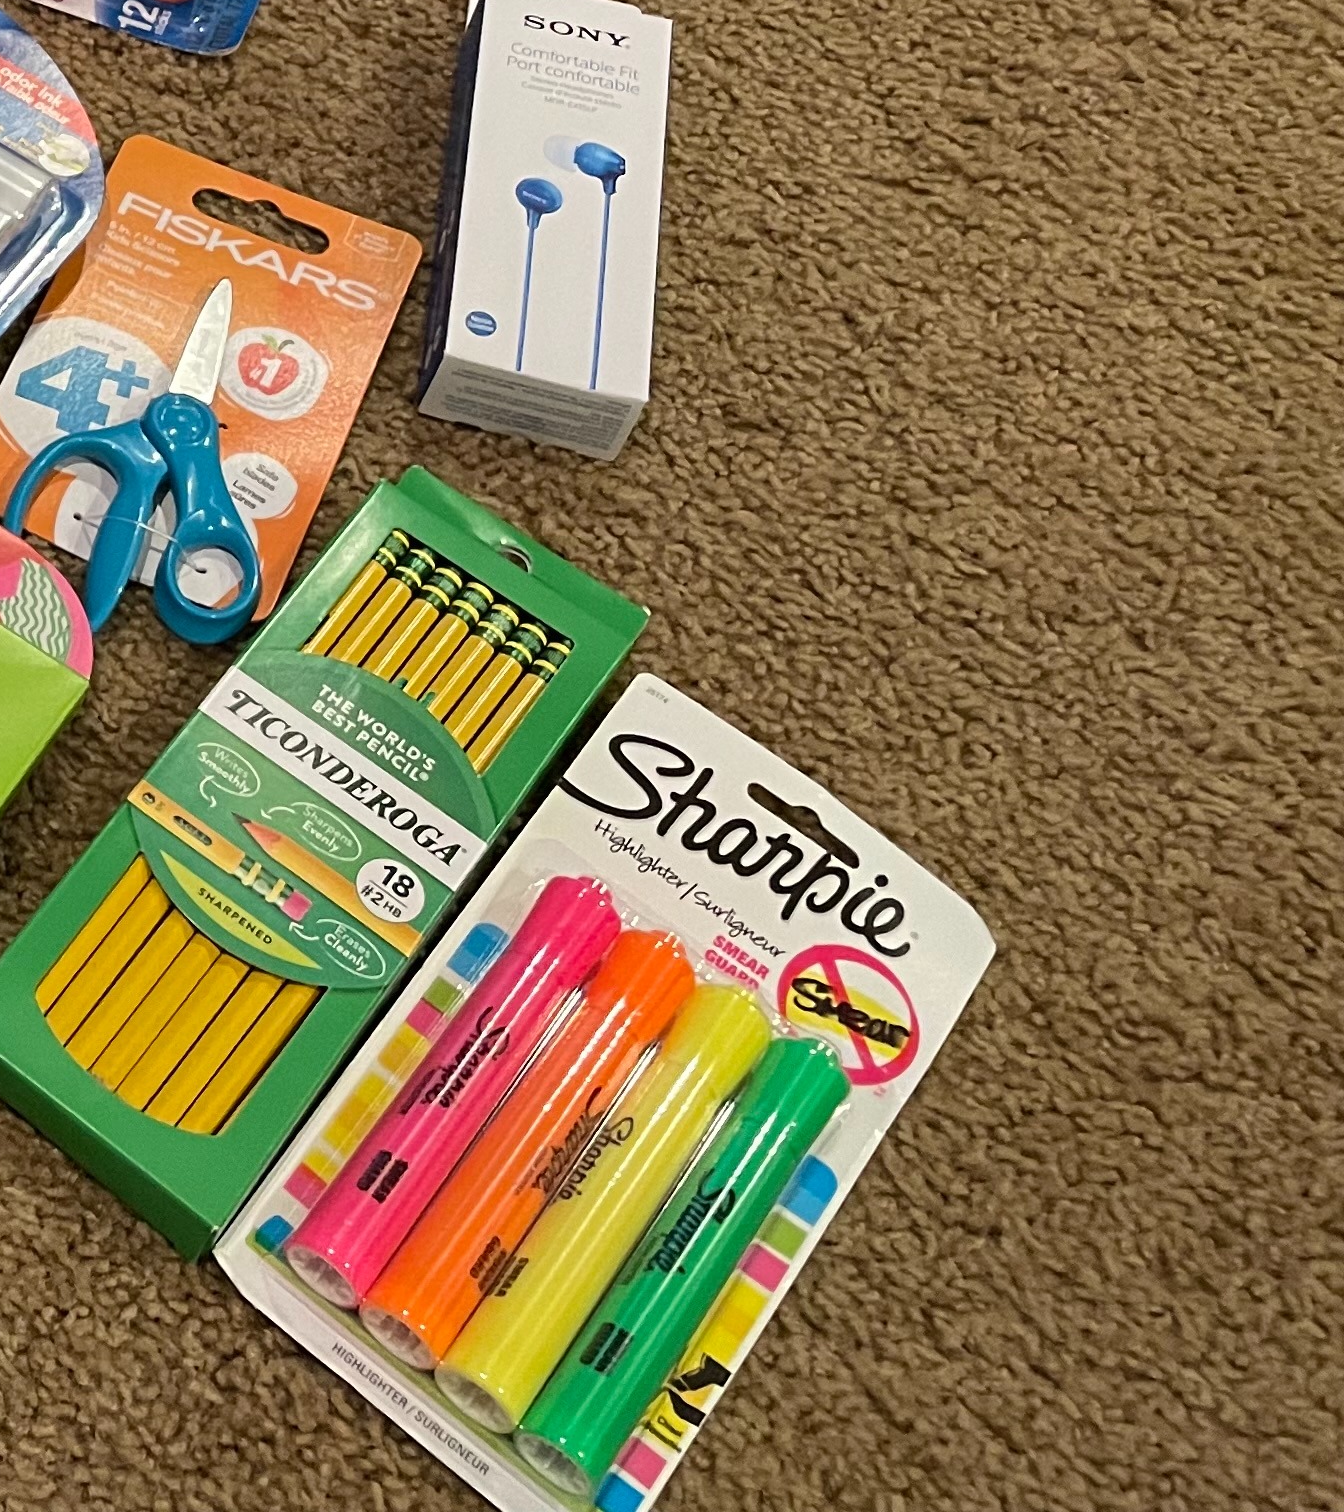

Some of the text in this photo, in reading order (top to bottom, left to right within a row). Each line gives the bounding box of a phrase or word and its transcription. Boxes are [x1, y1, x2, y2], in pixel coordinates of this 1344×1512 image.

[117, 0, 159, 32] 12
[524, 14, 630, 48] SONY
[0, 68, 38, 91] odor
[506, 55, 640, 97] Port confortable
[511, 42, 640, 81] Comfortable Fit
[117, 191, 376, 311] FISKARS
[311, 700, 357, 735] BEST
[318, 685, 437, 773] THE WORLD'S
[198, 751, 251, 795] Smoothly
[214, 746, 250, 780] Writes
[224, 688, 462, 868] TICONDEROGA
[301, 804, 354, 849] Sharpens
[302, 819, 340, 854] Evenly
[559, 733, 912, 958] Sharpie
[381, 863, 417, 899] 18
[593, 818, 688, 890] Highlighter
[694, 890, 788, 959] Surligneur
[196, 887, 274, 946] SHARPENED
[323, 932, 371, 972] Cleanly
[334, 924, 372, 960] Erases
[712, 934, 771, 980] SMEAR
[791, 977, 911, 1049] Smear
[332, 1342, 409, 1409] HIGHLIGHTER
[413, 1410, 492, 1478] SURLIGNEUR
